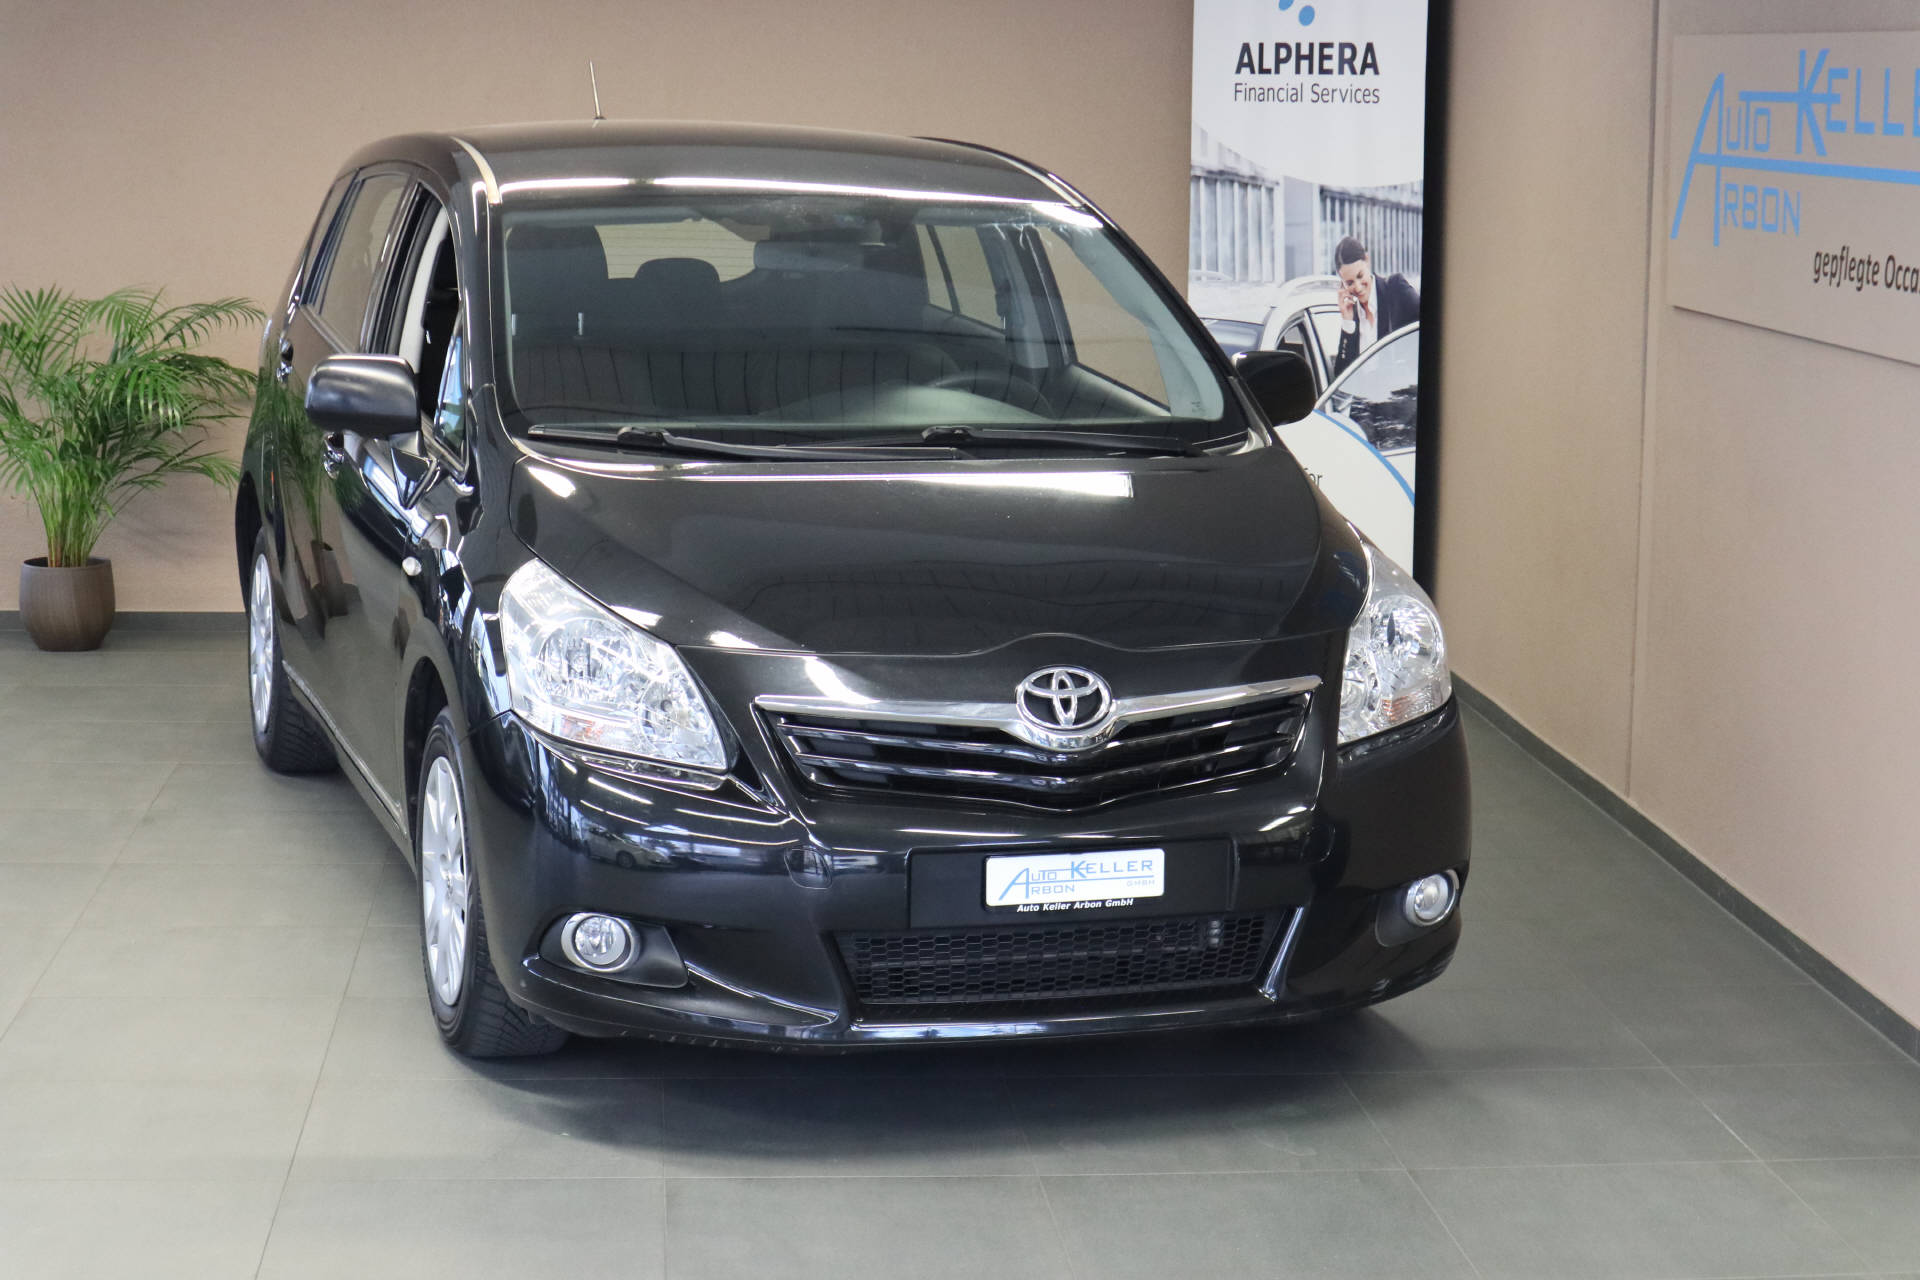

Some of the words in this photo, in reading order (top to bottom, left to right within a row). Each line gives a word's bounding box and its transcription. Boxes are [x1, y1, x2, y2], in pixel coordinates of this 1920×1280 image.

[1235, 42, 1380, 75] ALPHERA
[1234, 82, 1303, 103] Financial
[1310, 83, 1380, 104] Services
[1814, 245, 1880, 292] gepflegte
[1884, 254, 1920, 294] Occa
[1071, 860, 1153, 879] KELLER
[1017, 904, 1040, 912] Auto
[1043, 902, 1071, 911] Keller
[1074, 900, 1102, 909] Arbon
[1105, 898, 1134, 907] GmbH
